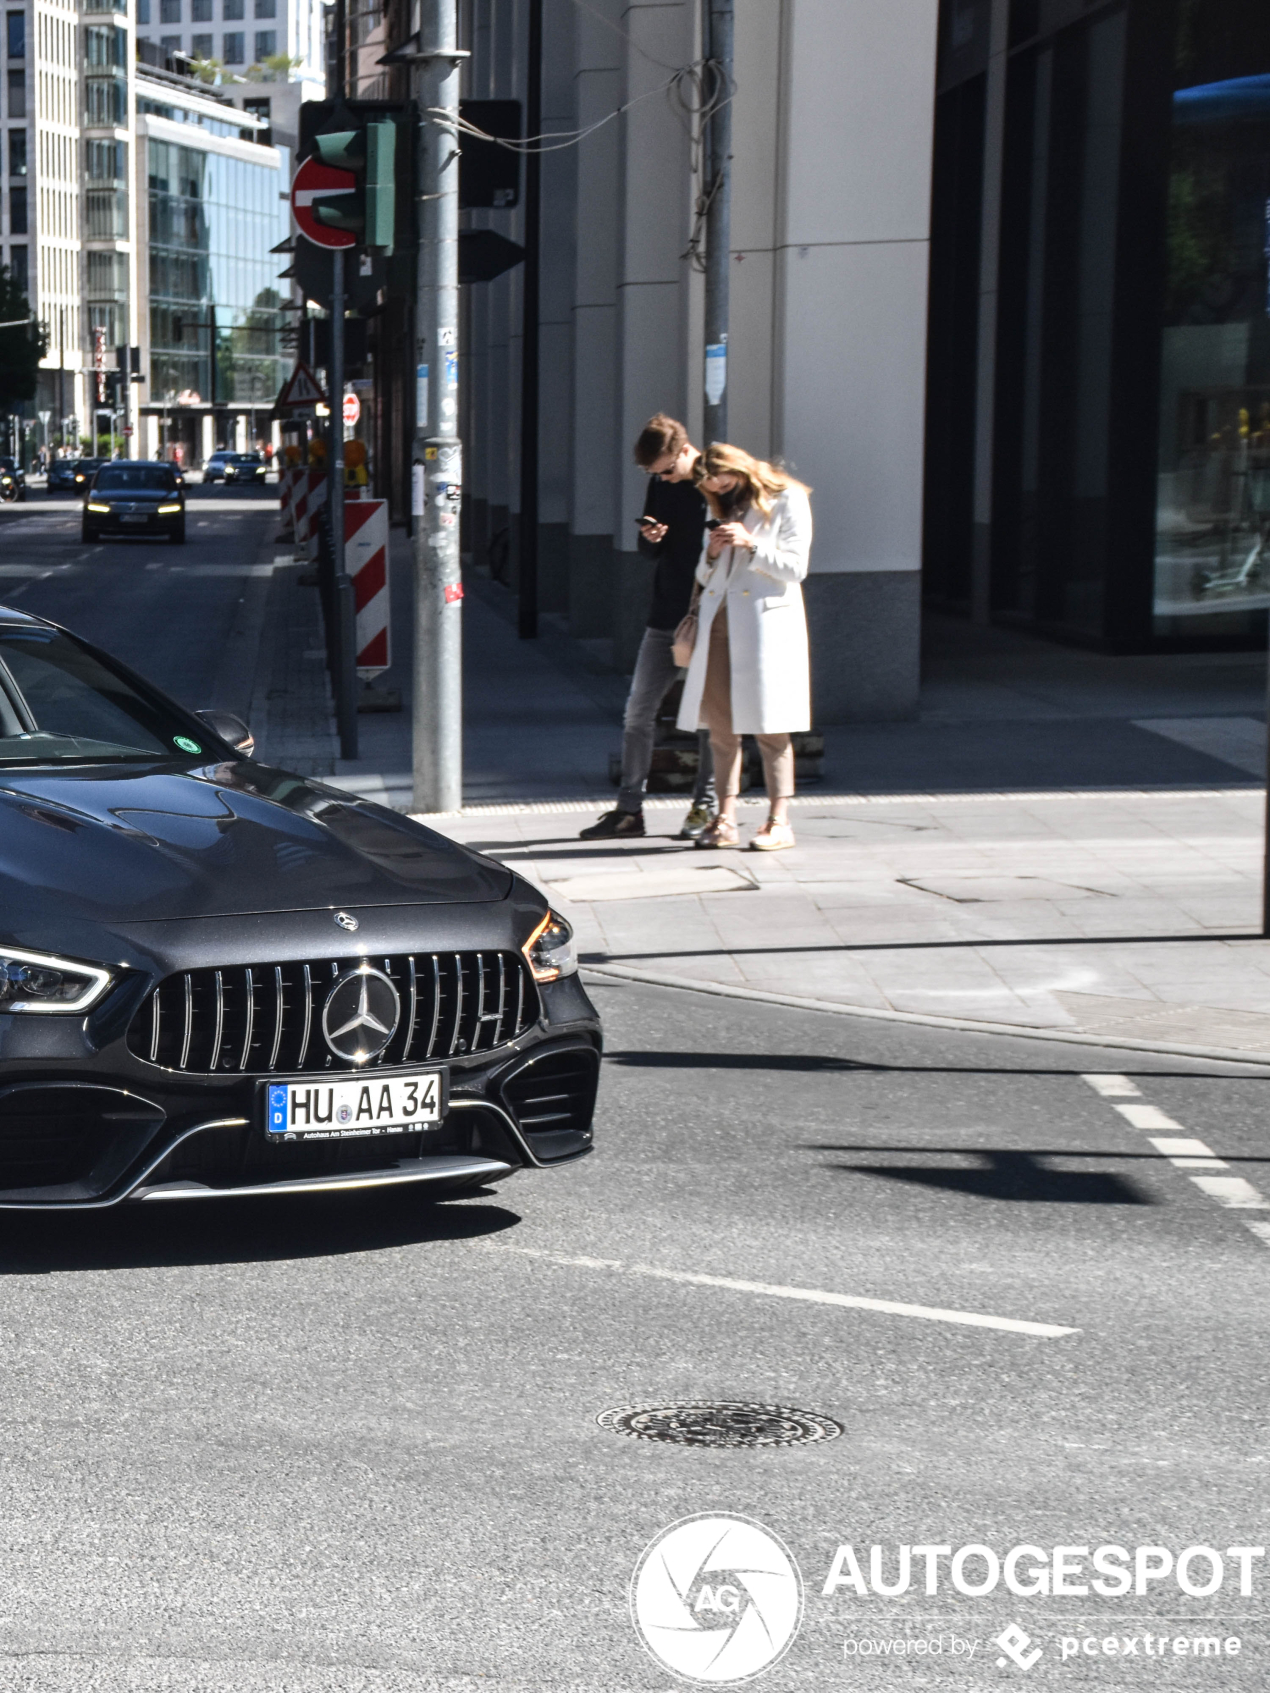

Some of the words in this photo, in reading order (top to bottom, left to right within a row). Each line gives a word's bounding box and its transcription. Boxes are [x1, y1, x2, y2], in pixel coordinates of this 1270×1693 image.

[291, 1088, 334, 1125] HU
[355, 1084, 394, 1121] AA
[402, 1080, 436, 1117] 34
[274, 1112, 283, 1124] D
[303, 1131, 330, 1139] Autohaus
